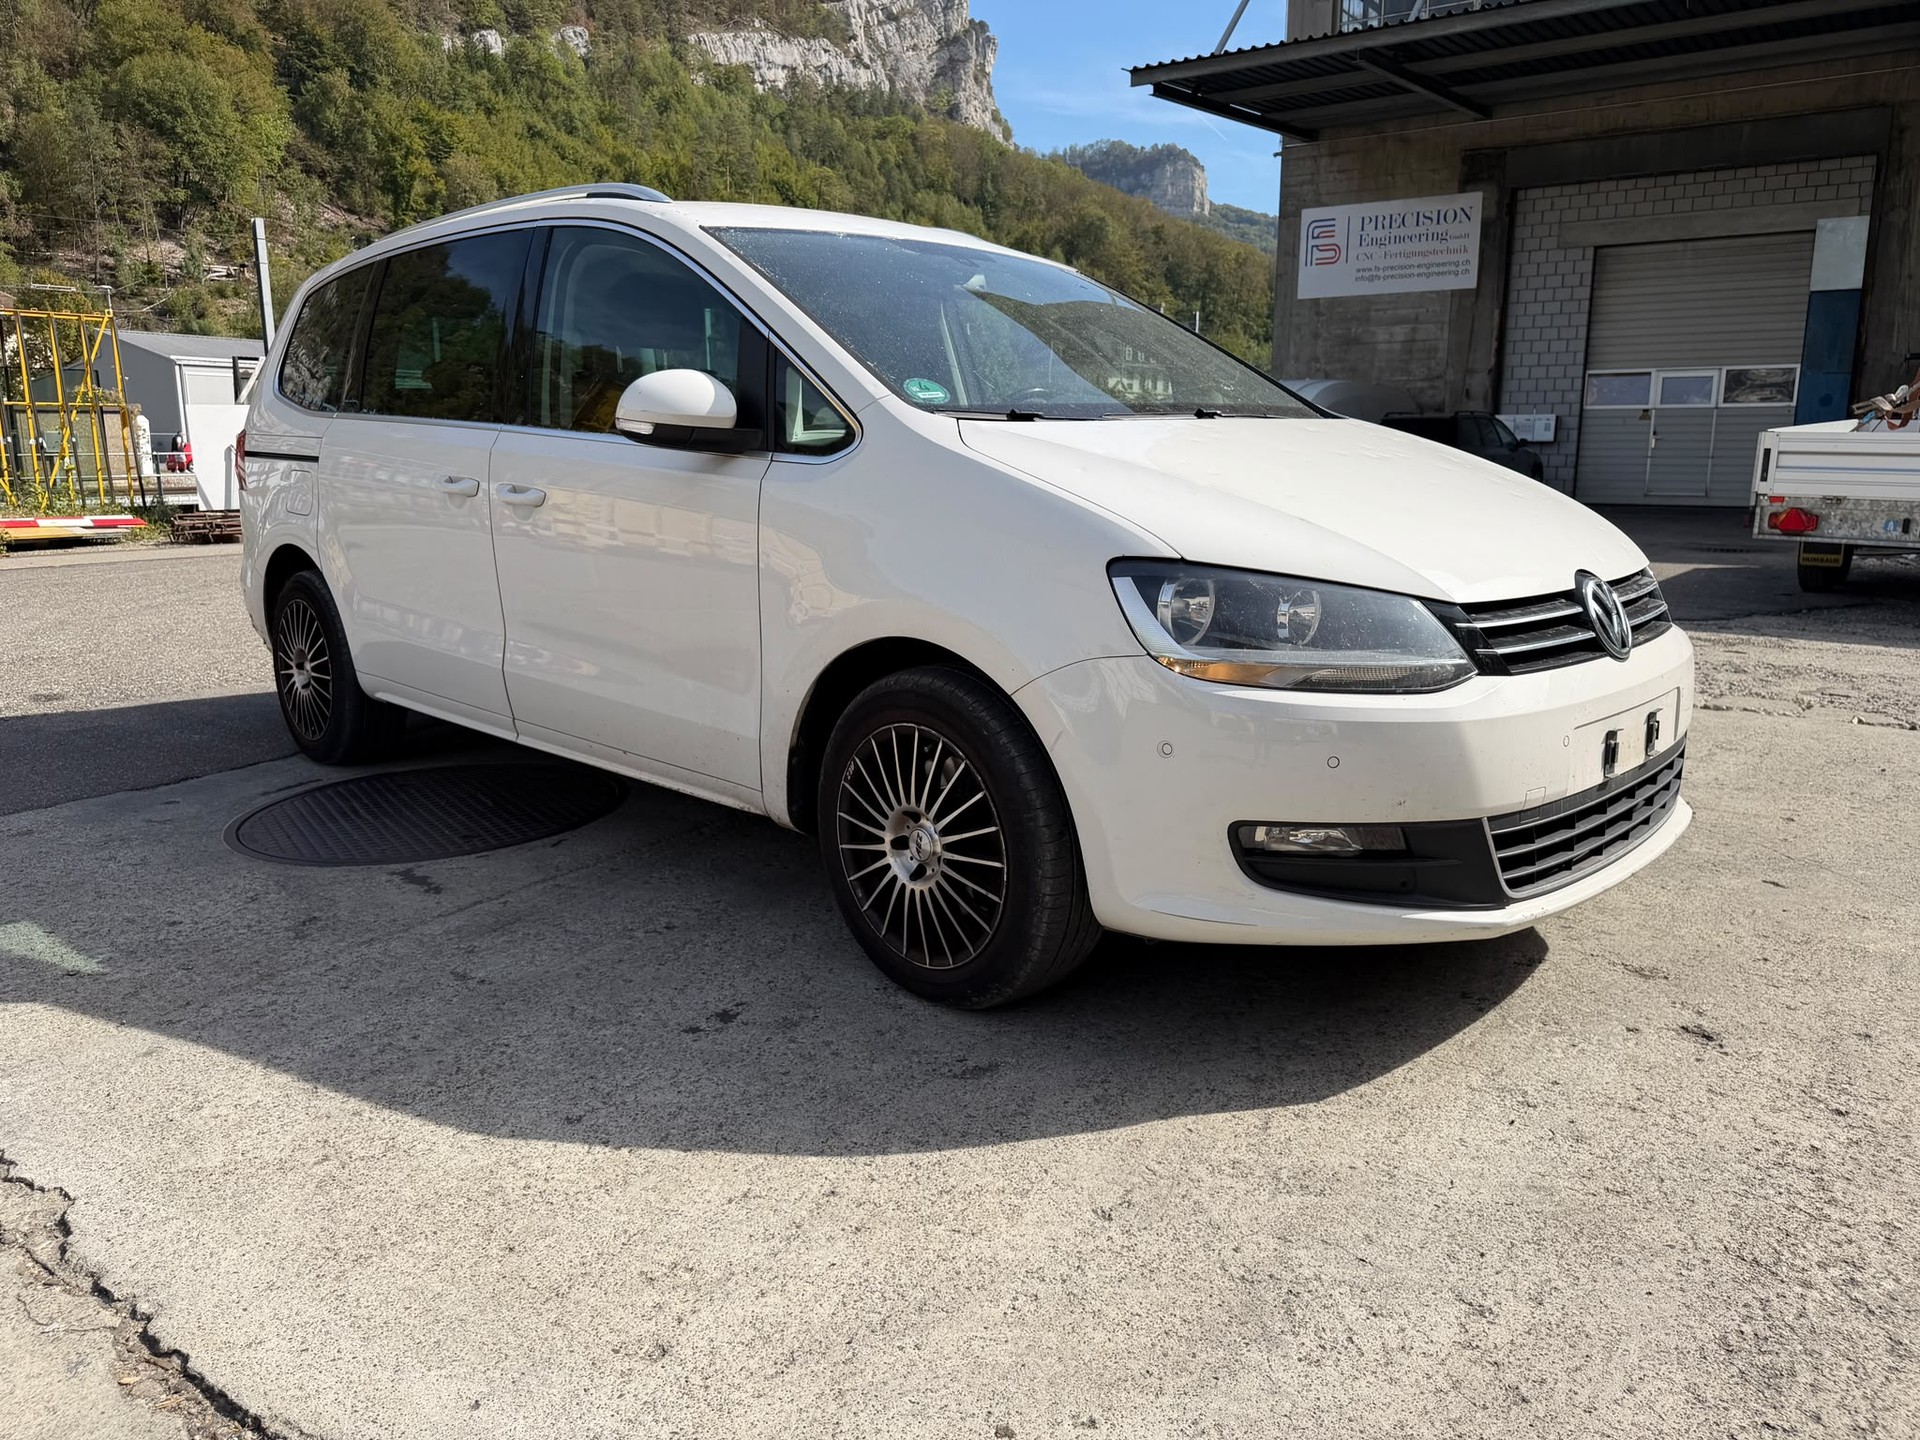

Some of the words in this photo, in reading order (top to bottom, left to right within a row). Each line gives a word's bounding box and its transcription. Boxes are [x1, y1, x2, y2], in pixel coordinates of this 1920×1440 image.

[1360, 206, 1474, 232] PRECISION
[1359, 229, 1449, 249] Engineering
[1356, 252, 1376, 262] CNC
[1383, 245, 1469, 260] Fertigungstechnik
[1355, 259, 1471, 274] www.fs-precision-engineering.ch
[1355, 268, 1470, 282] info@fs-precision-engineering.ch
